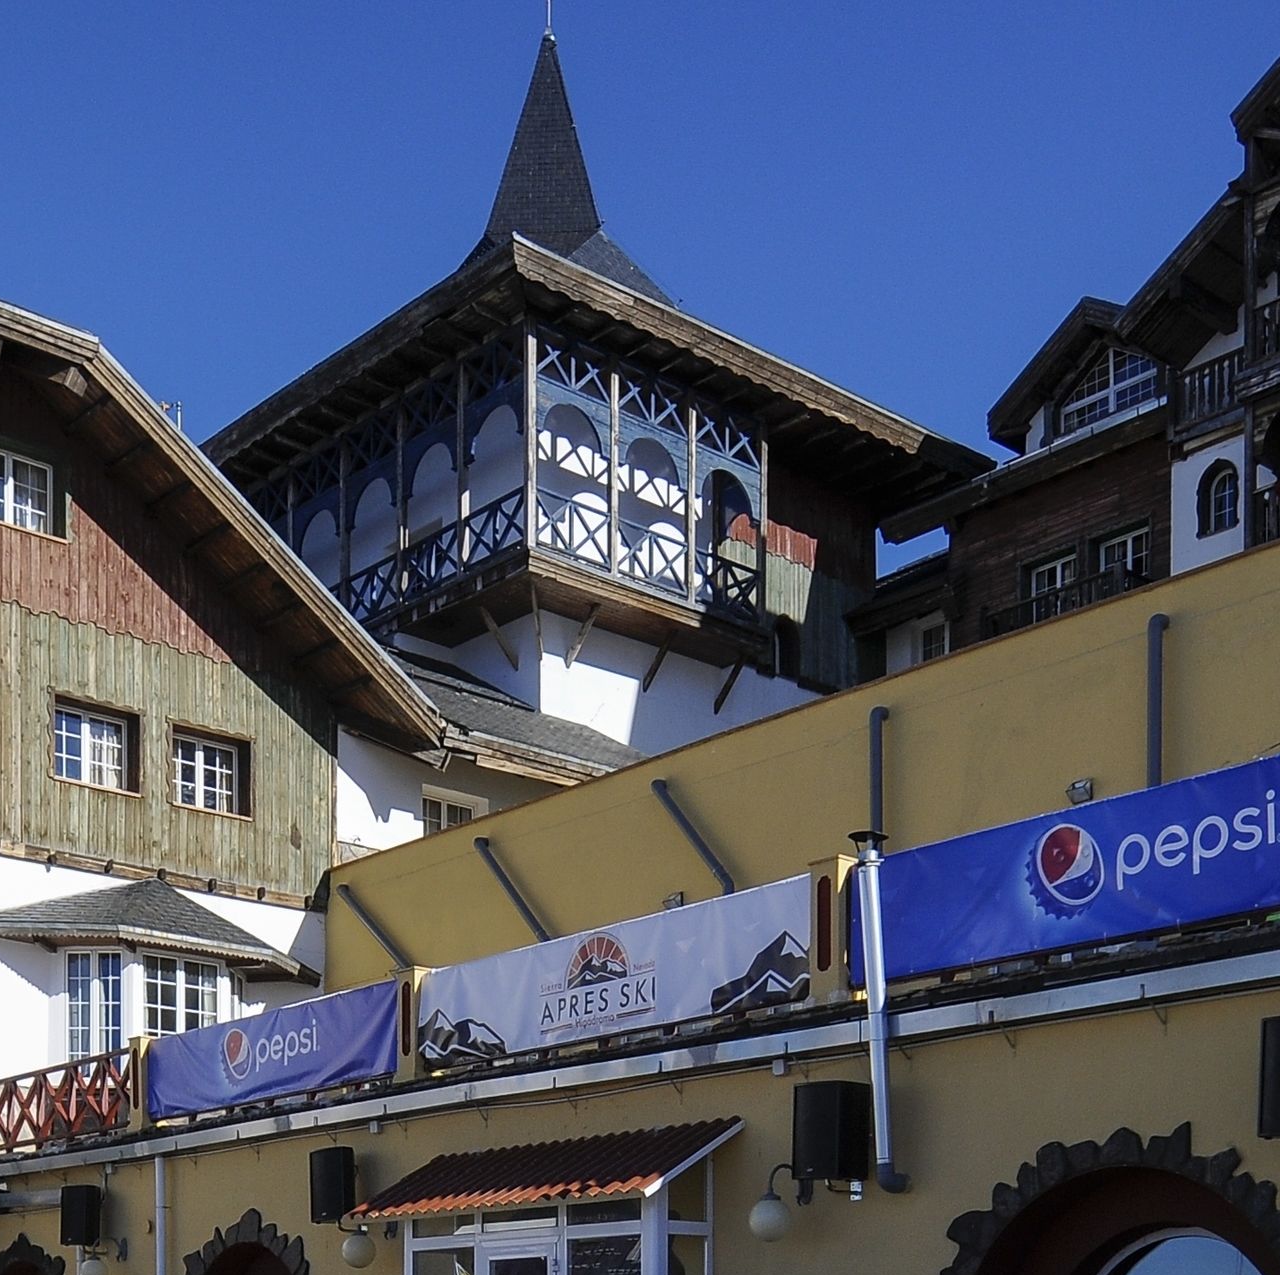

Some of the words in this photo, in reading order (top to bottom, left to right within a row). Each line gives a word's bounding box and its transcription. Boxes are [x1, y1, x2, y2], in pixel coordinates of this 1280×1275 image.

[1116, 789, 1276, 891] pepsi
[541, 988, 609, 1025] APRES
[620, 977, 656, 1008] SKI
[256, 1019, 317, 1073] pepsi
